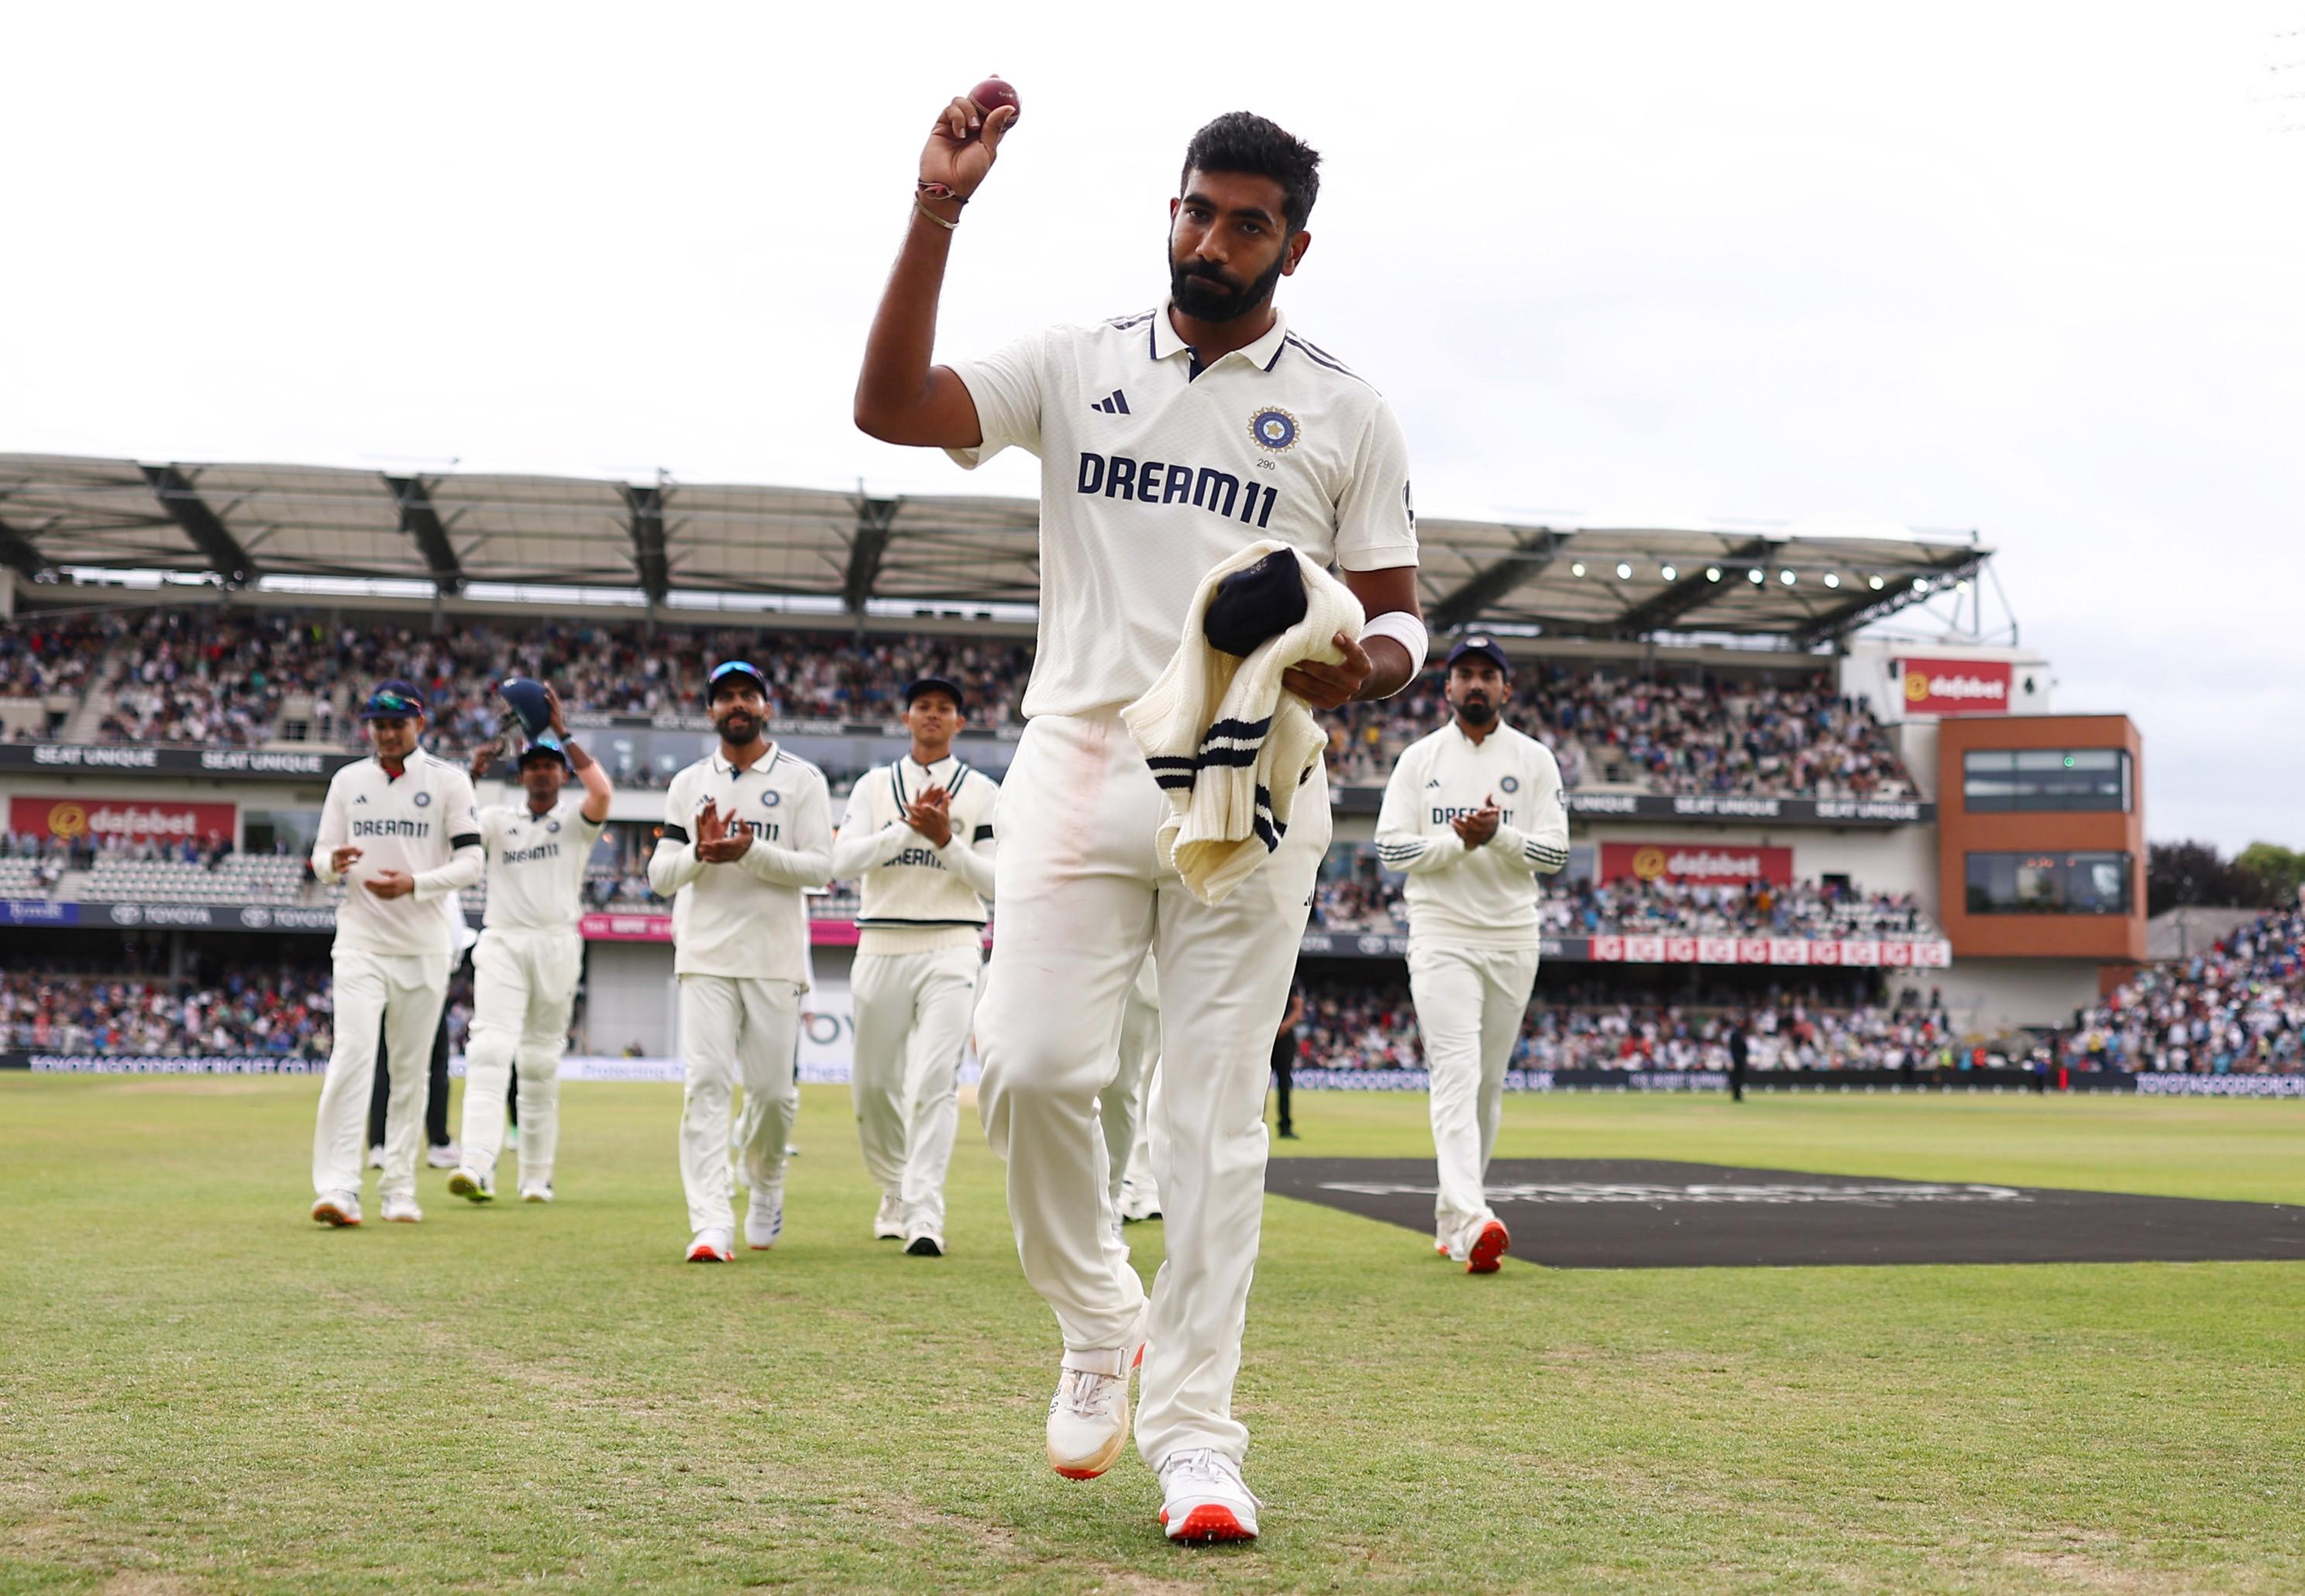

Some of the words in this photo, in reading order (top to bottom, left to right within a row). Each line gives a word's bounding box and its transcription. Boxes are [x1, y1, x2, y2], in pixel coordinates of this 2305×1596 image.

[1257, 458, 1275, 471] 290
[1077, 452, 1278, 529] DREAM11
[1928, 673, 2004, 700] dafabet
[34, 746, 81, 764] SEAT
[83, 748, 157, 768] UNIQUE
[201, 751, 248, 769] SEAT
[249, 753, 323, 773] UNIQUE
[1674, 796, 1715, 813] SEAT
[1717, 798, 1780, 817] UNIQUE
[1816, 801, 1856, 817] SEAT
[1859, 802, 1919, 820] UNIQUE
[88, 807, 196, 836] dafabet
[353, 820, 429, 838] DREAM11
[1668, 850, 1760, 876] dafabet
[145, 906, 212, 925] TOYOTA
